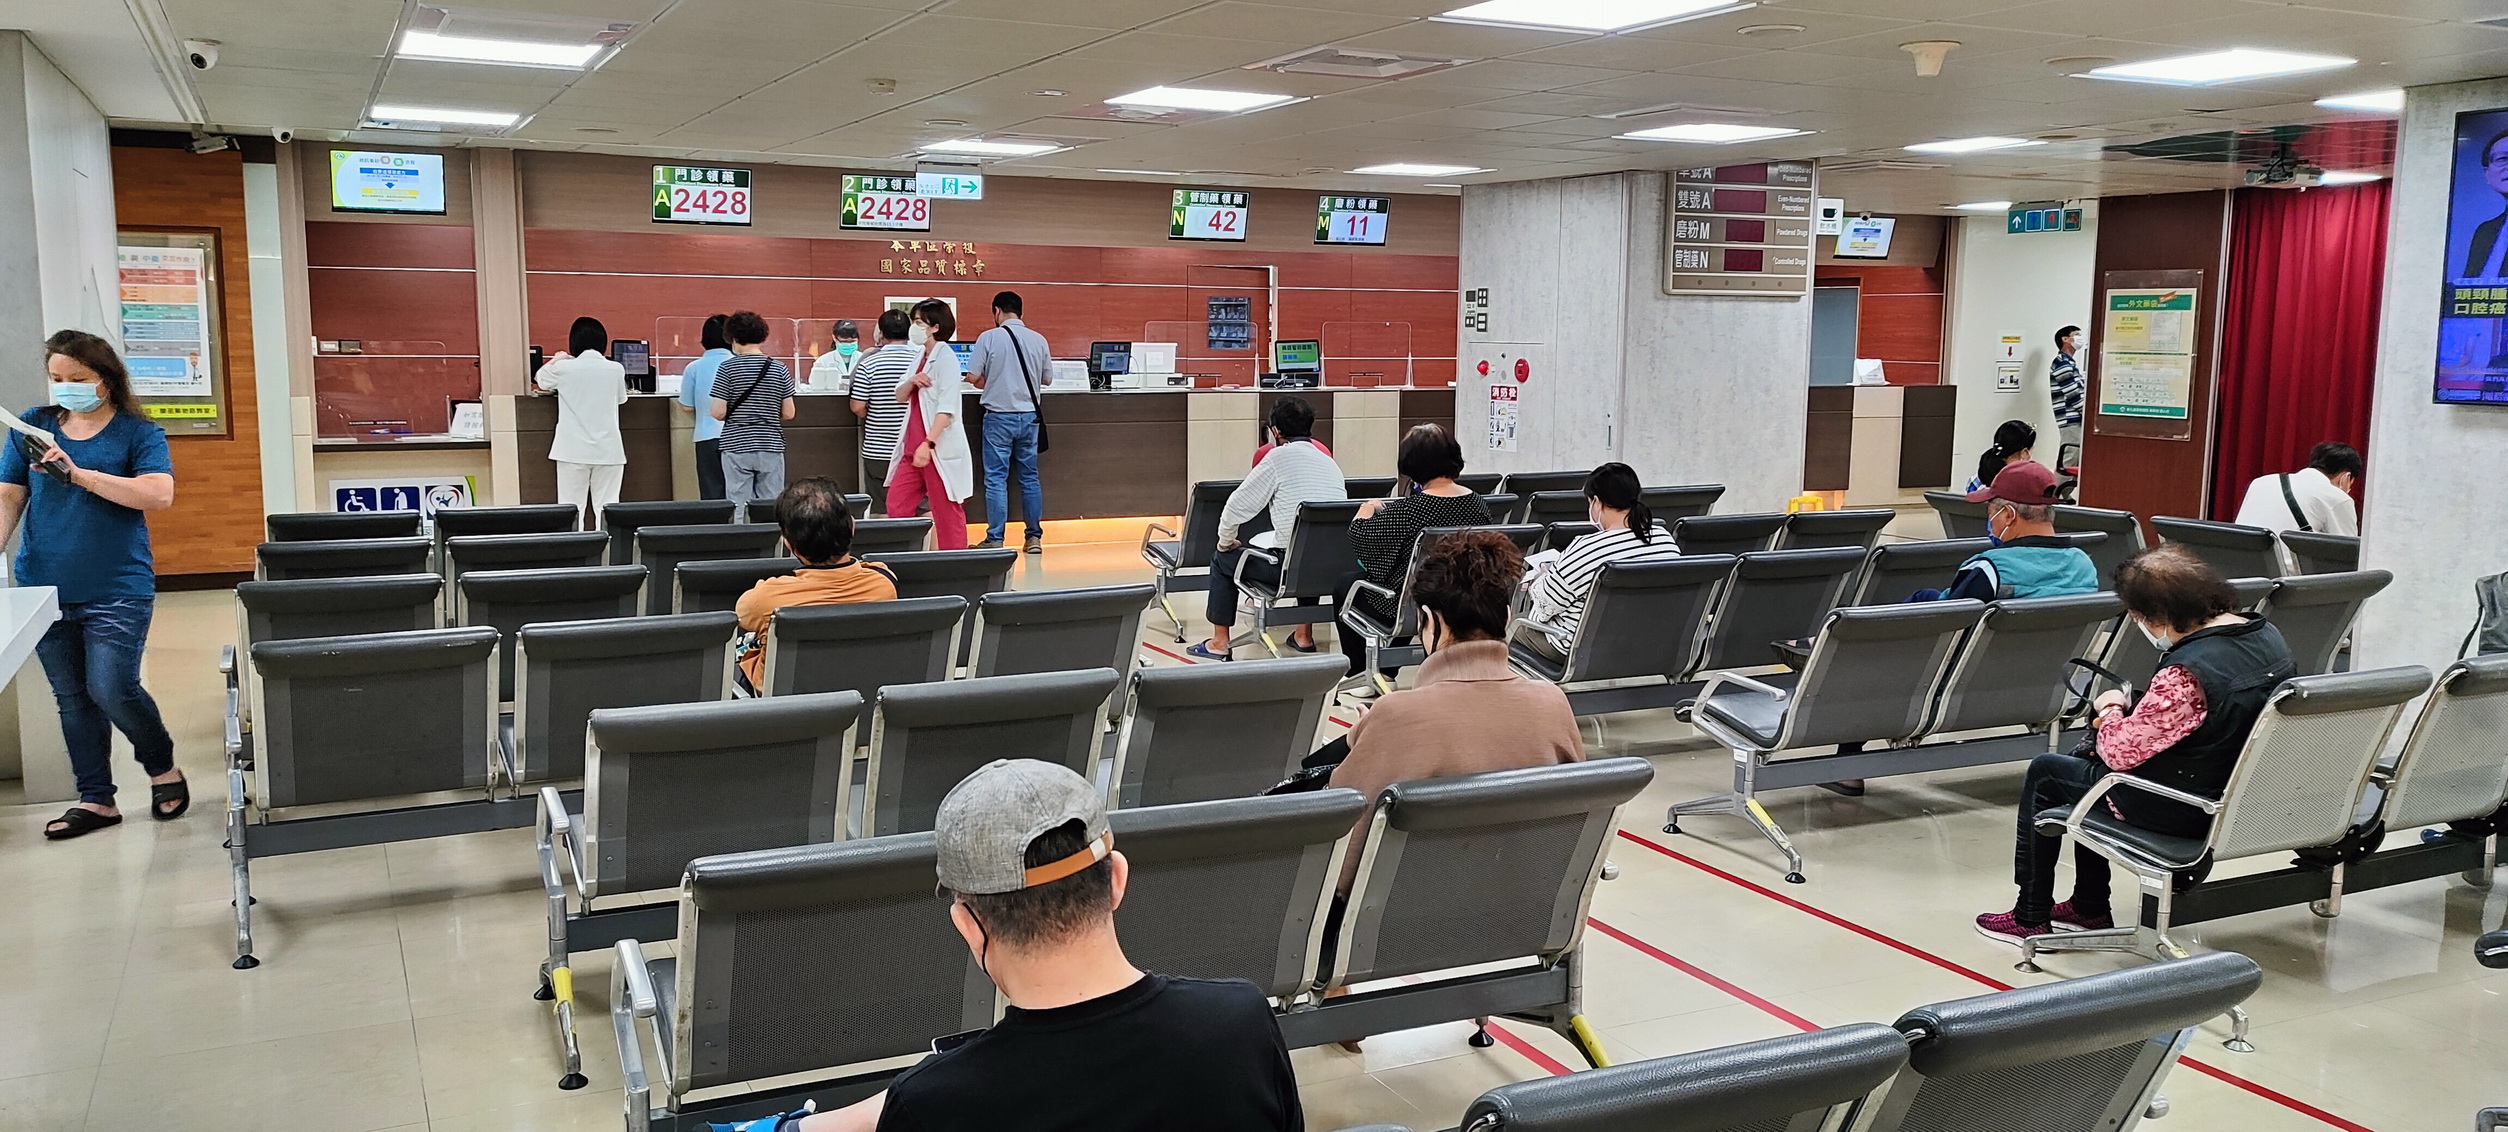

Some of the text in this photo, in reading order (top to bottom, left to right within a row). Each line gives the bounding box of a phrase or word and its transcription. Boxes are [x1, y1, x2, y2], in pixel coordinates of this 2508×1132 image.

[655, 167, 666, 183] 1
[674, 168, 735, 183] 門診領藥
[843, 176, 855, 192] 2
[861, 177, 916, 191] 門診領藥
[654, 189, 671, 207] A
[673, 188, 747, 215] 2428
[842, 197, 857, 214] A
[1174, 190, 1184, 205] 3
[1320, 197, 1329, 211] 4
[859, 196, 927, 222] 2428
[1172, 210, 1184, 226] N
[1207, 210, 1237, 232] 42
[1317, 216, 1330, 231] M
[1346, 215, 1368, 236] 11
[880, 258, 985, 277] 國家品質標章
[2453, 302, 2507, 315] 口腔癌
[1491, 387, 1517, 398] 消防栓
